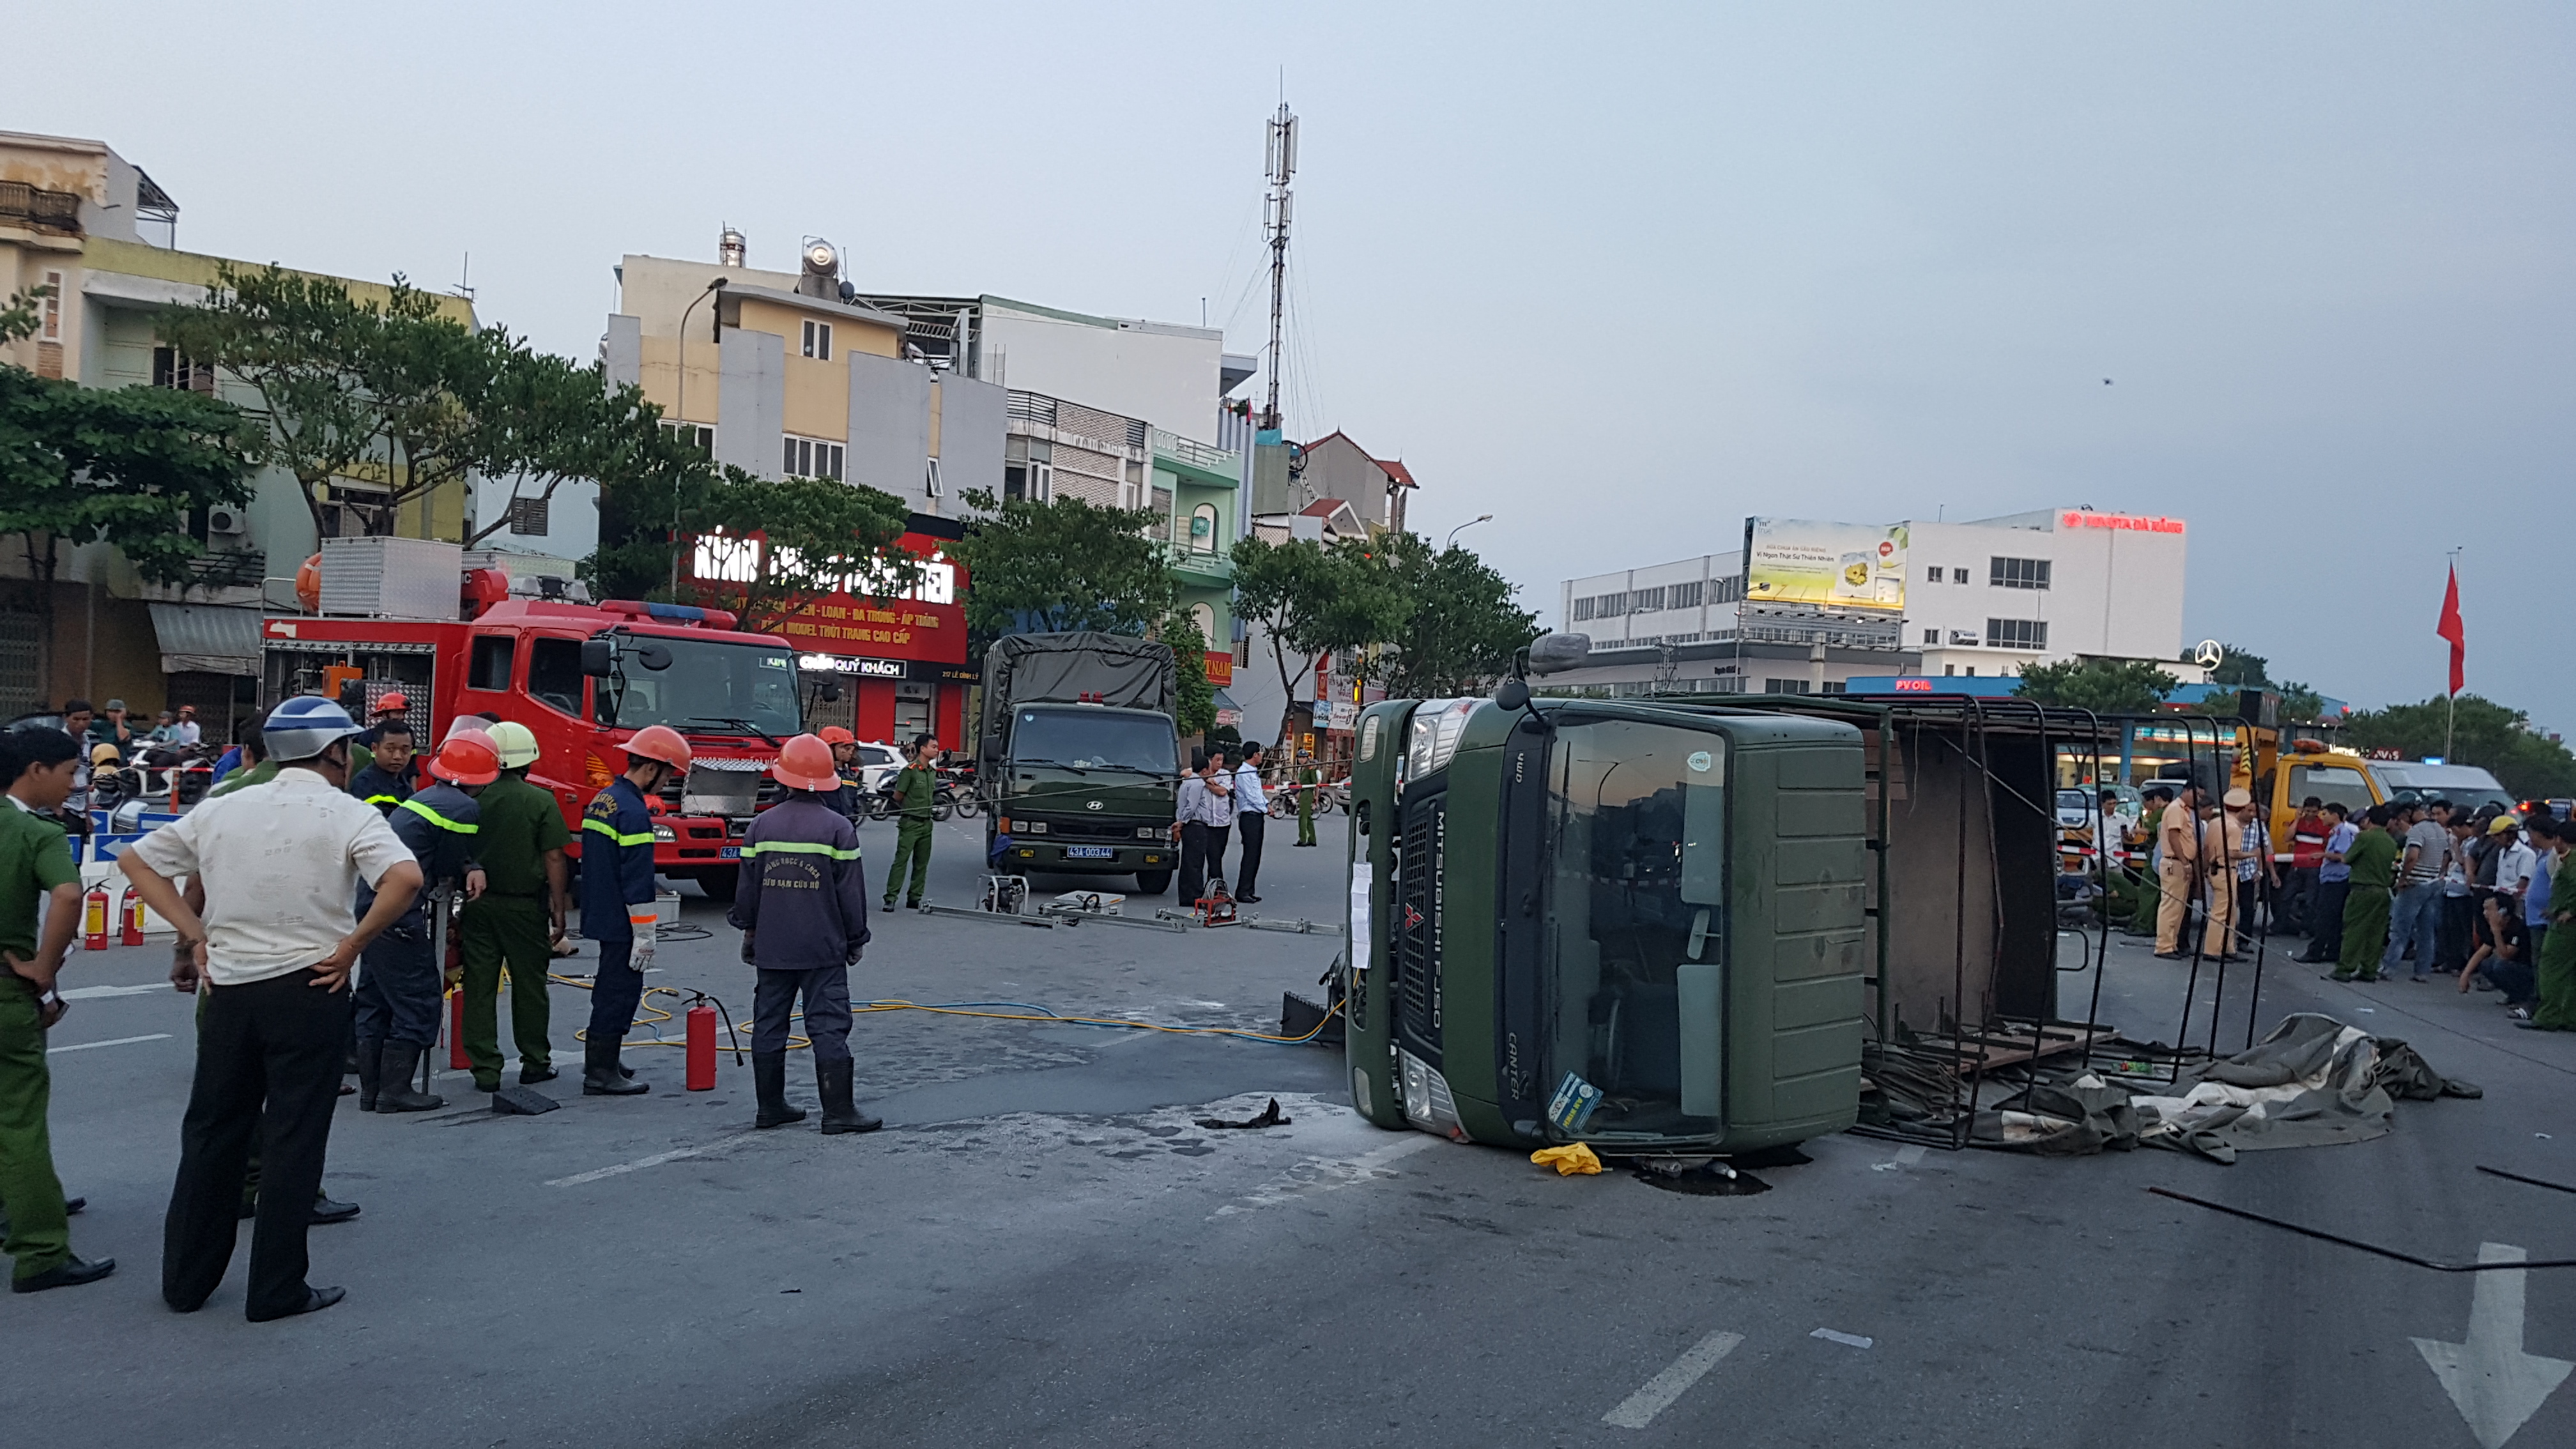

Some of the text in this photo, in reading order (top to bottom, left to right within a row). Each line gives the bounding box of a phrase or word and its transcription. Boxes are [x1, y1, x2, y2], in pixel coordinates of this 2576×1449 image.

[873, 630, 891, 643] CAO
[861, 661, 900, 675] KHÁCH
[1204, 659, 1232, 677] TNAM
[1896, 680, 1932, 691] PV OIL
[1434, 811, 1445, 952] MITSUBISHI
[1508, 1032, 1519, 1100] CANTER
